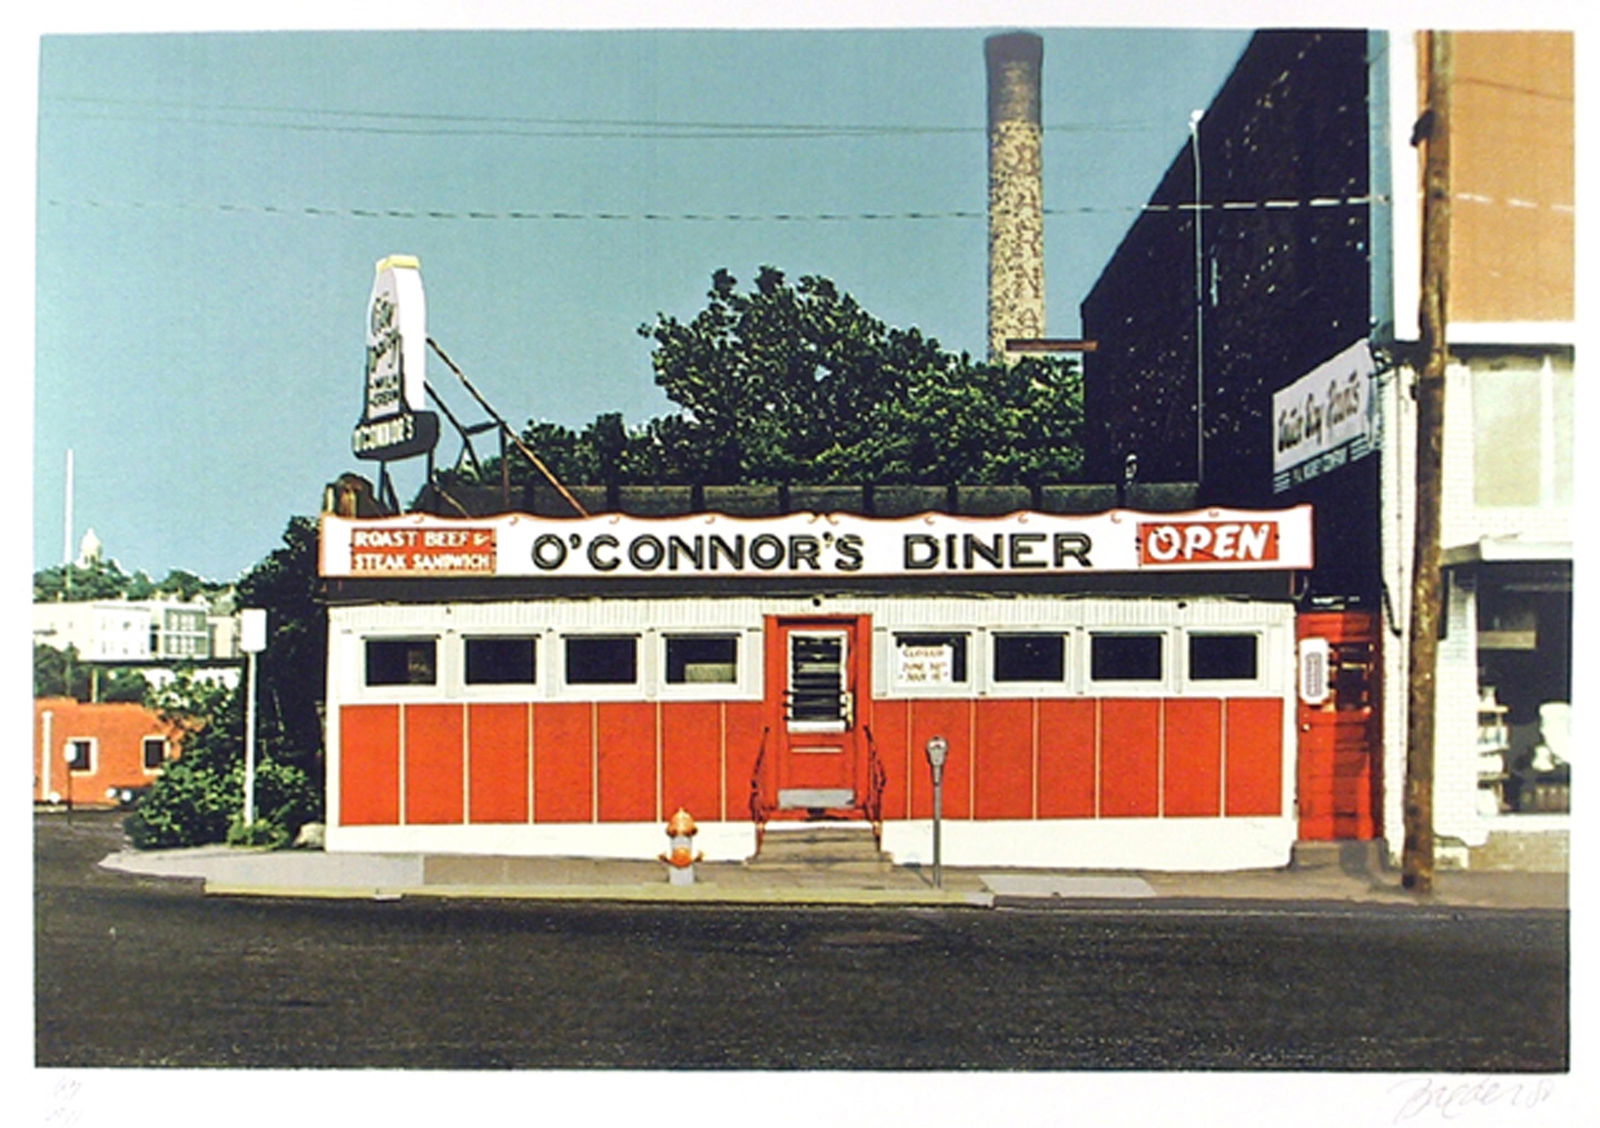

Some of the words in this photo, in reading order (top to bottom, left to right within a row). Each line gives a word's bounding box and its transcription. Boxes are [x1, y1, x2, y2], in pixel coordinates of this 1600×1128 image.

[355, 530, 416, 547] ROAST
[424, 530, 469, 547] BEEF
[531, 532, 864, 570] O'CONNOR'S
[904, 531, 1093, 569] DINER
[1148, 523, 1270, 561] OPEN
[355, 552, 407, 570] STEAK
[412, 551, 489, 570] SANDWICH
